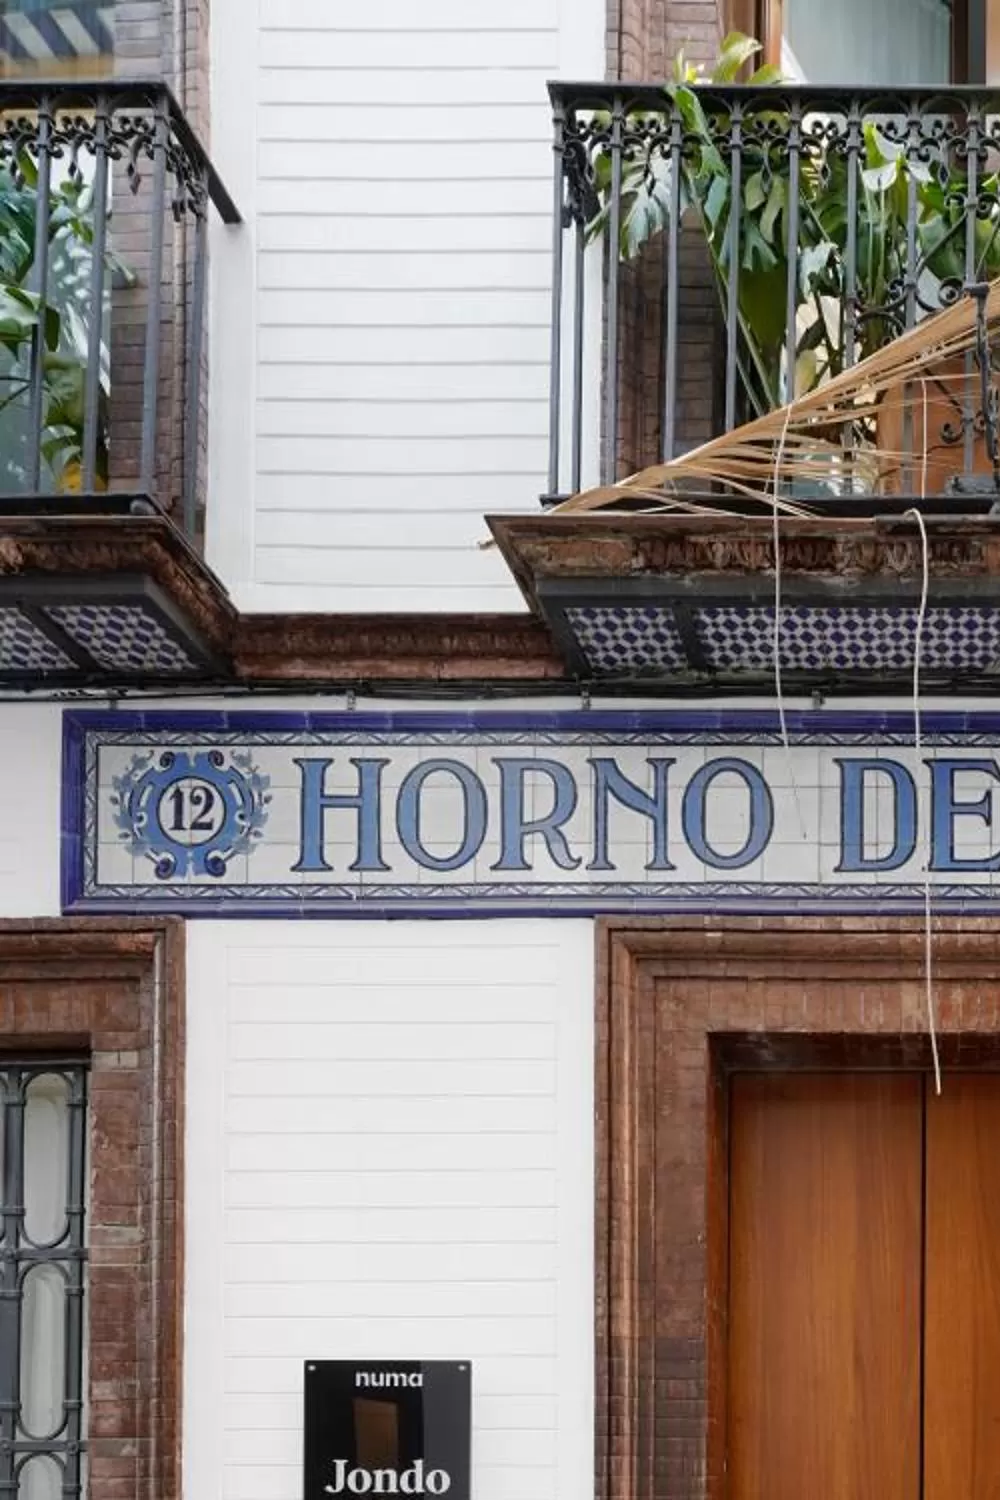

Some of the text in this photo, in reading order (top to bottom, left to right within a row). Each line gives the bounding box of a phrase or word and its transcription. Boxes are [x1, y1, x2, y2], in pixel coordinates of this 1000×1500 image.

[167, 786, 216, 832] 12
[290, 756, 775, 873] HORNO
[355, 1371, 424, 1388] numa
[324, 1458, 452, 1494] Jondo
